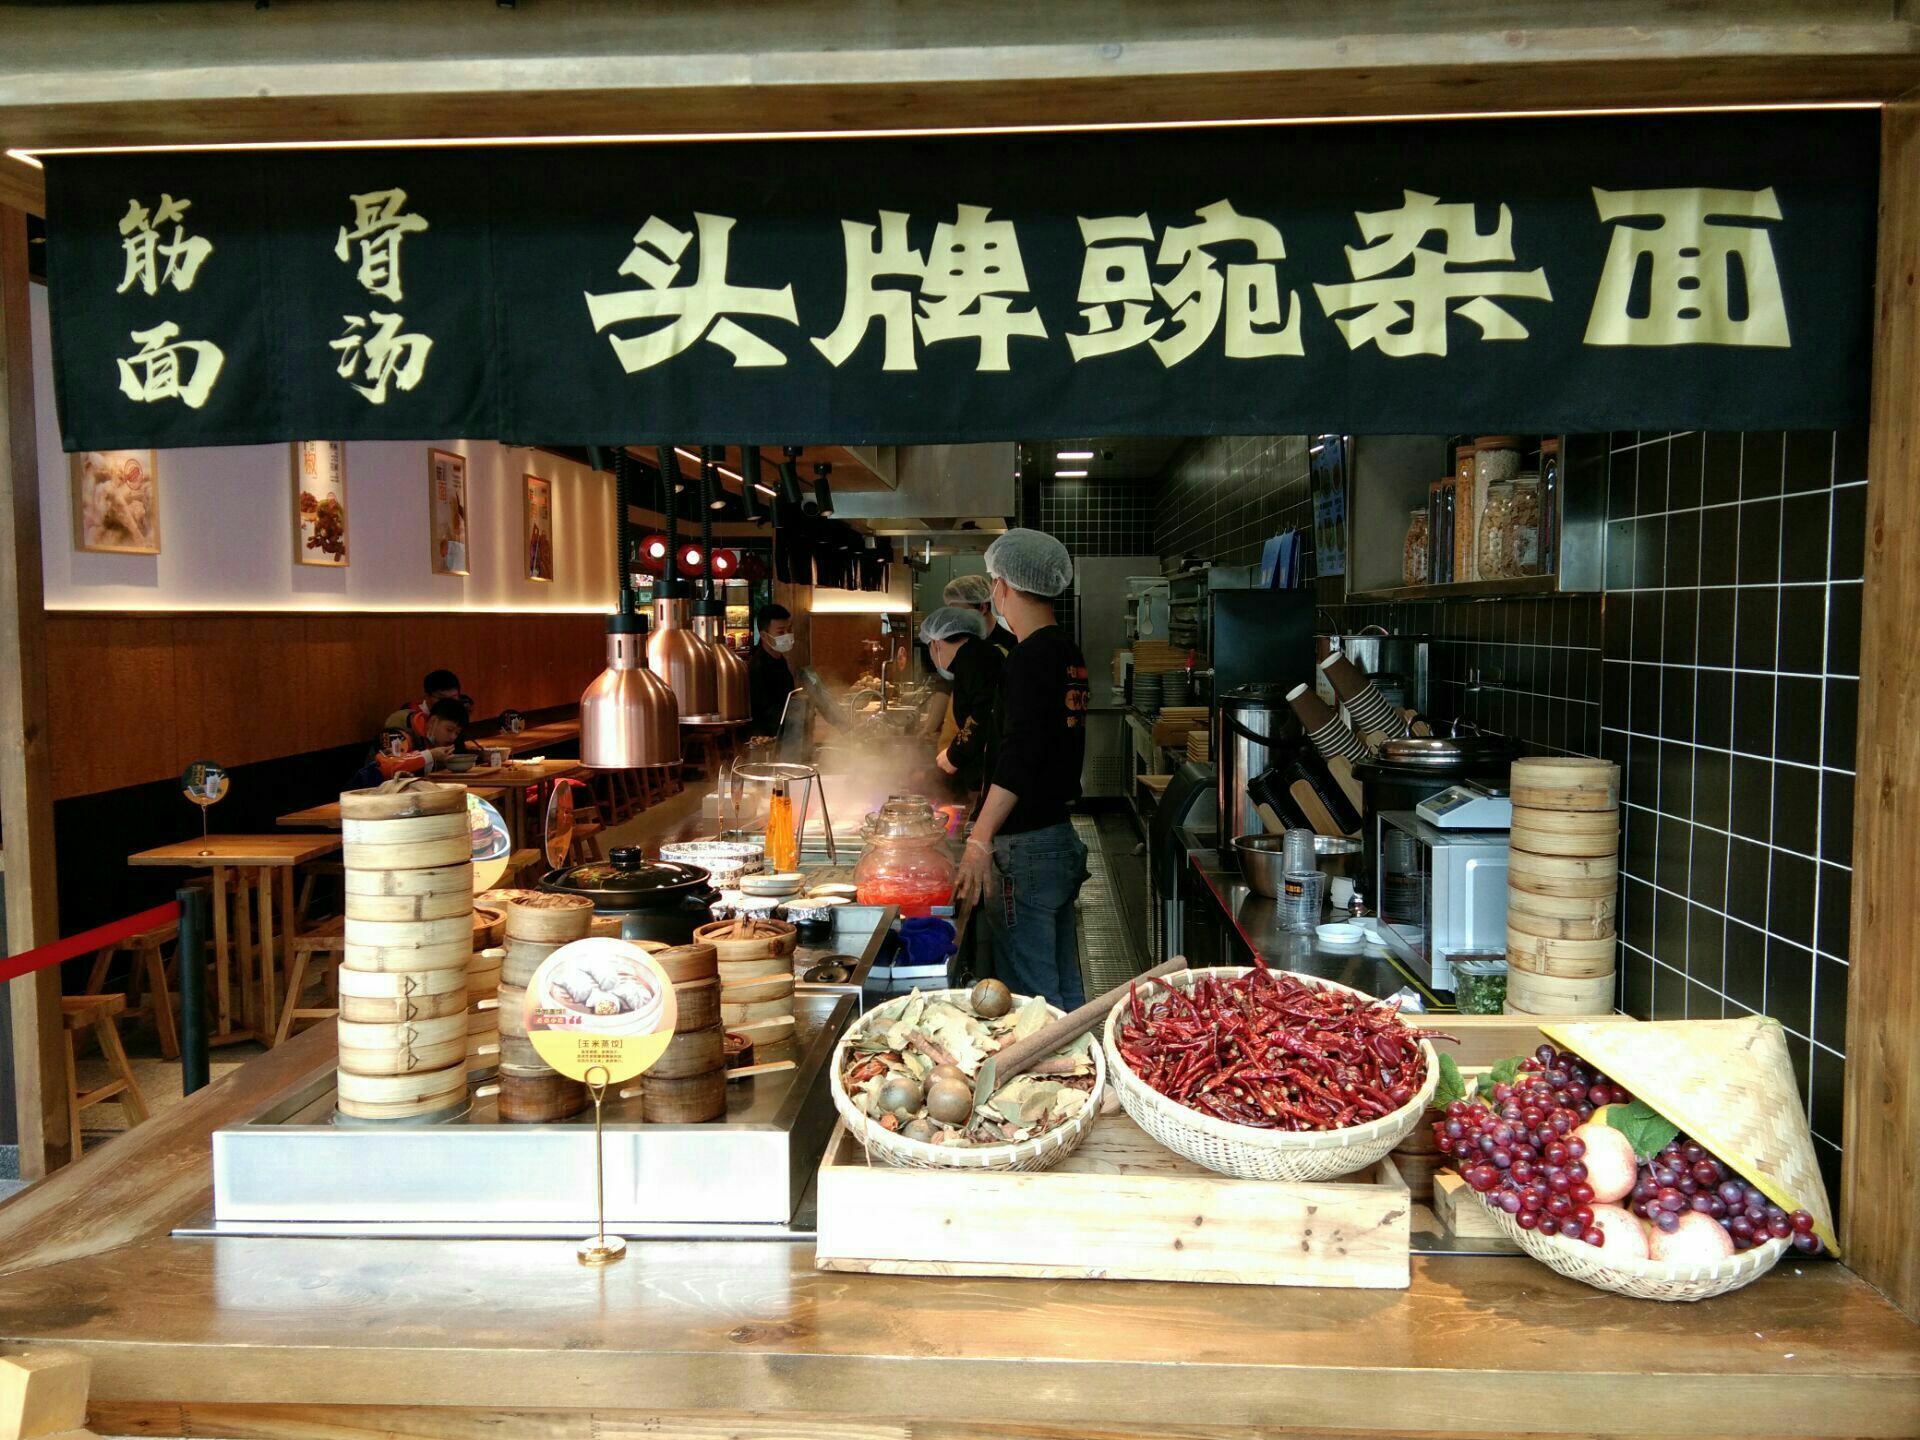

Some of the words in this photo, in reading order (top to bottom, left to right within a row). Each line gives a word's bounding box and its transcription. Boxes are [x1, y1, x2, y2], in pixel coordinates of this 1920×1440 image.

[117, 194, 225, 408] 筋面
[329, 188, 434, 404] 骨汤
[584, 188, 1791, 373] 头牌豌杂面
